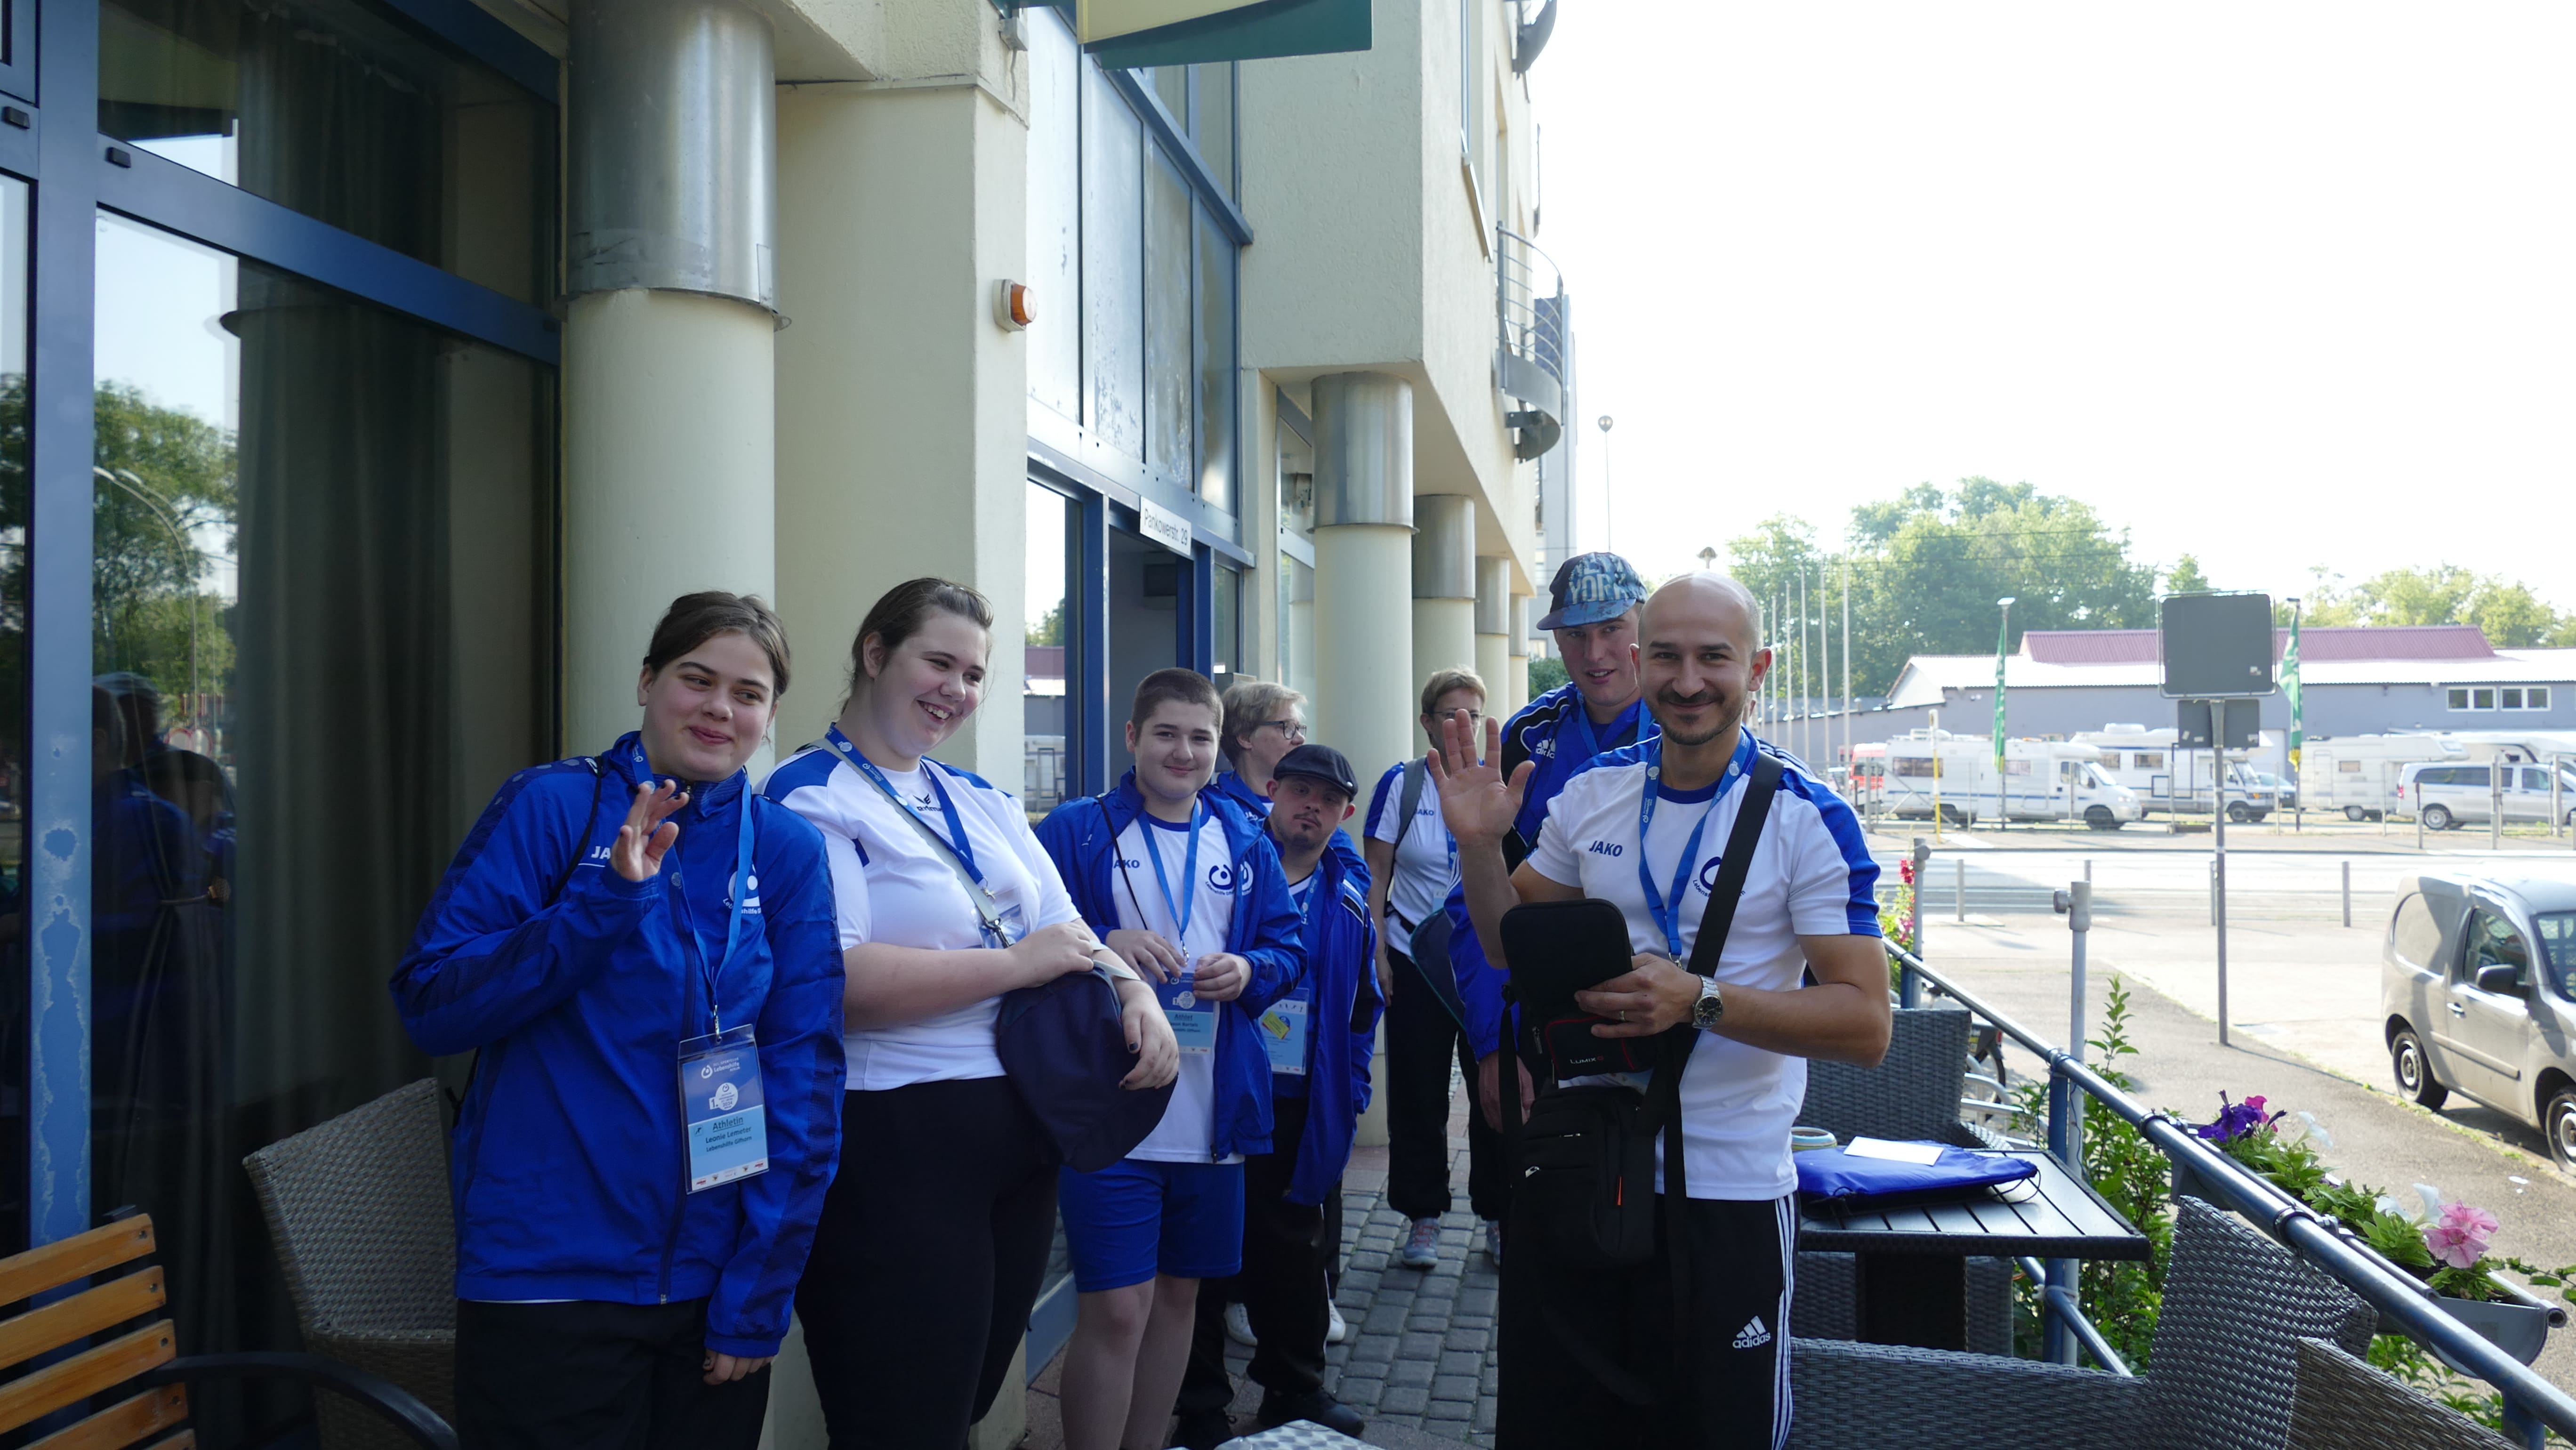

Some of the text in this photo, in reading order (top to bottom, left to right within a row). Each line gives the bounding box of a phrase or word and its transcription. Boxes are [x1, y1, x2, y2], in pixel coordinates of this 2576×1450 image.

[1181, 528, 1188, 546] 29
[591, 846, 611, 860] JA
[1589, 840, 1623, 857] JAKO
[1113, 860, 1140, 869] AKO
[723, 898, 757, 914] Lebshilfe
[714, 1062, 740, 1072] Lebenshilfe
[711, 1099, 718, 1108] 1.
[712, 1116, 743, 1131] Athletin
[706, 1133, 726, 1144] Leonie
[706, 1141, 733, 1152] Lebenshilfe
[1732, 1332, 1771, 1348] adidas
